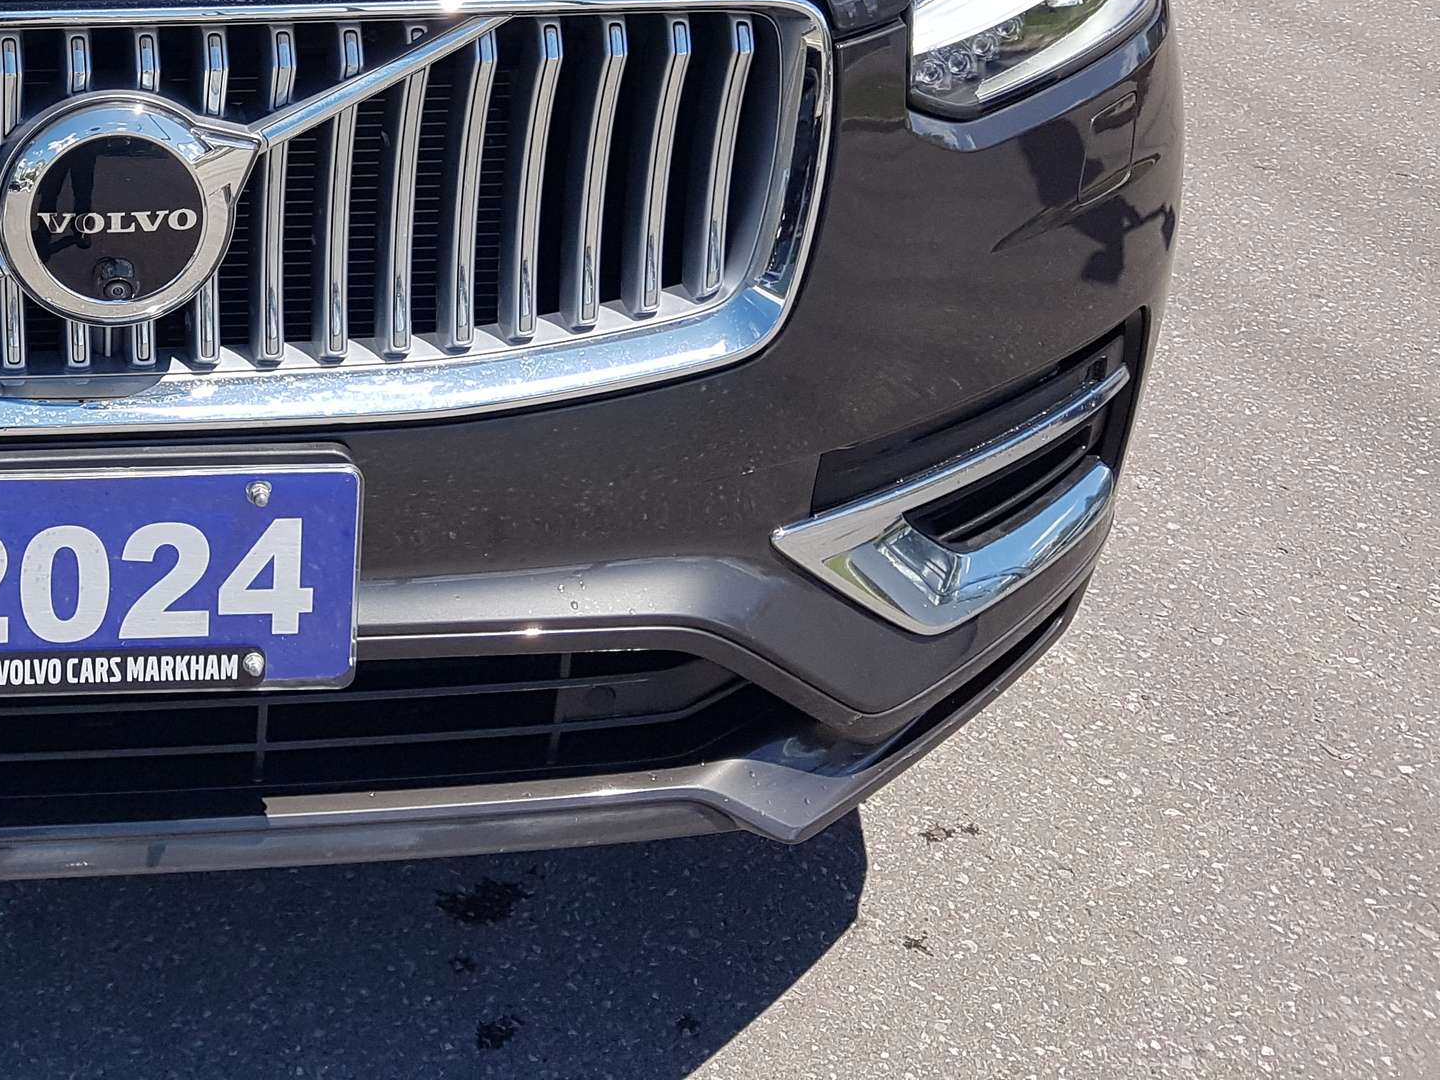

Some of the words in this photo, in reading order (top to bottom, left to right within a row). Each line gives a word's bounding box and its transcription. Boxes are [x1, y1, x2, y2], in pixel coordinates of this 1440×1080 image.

[37, 208, 197, 234] VOLVO
[66, 656, 121, 683] CARS
[126, 654, 238, 682] MARKHAM
